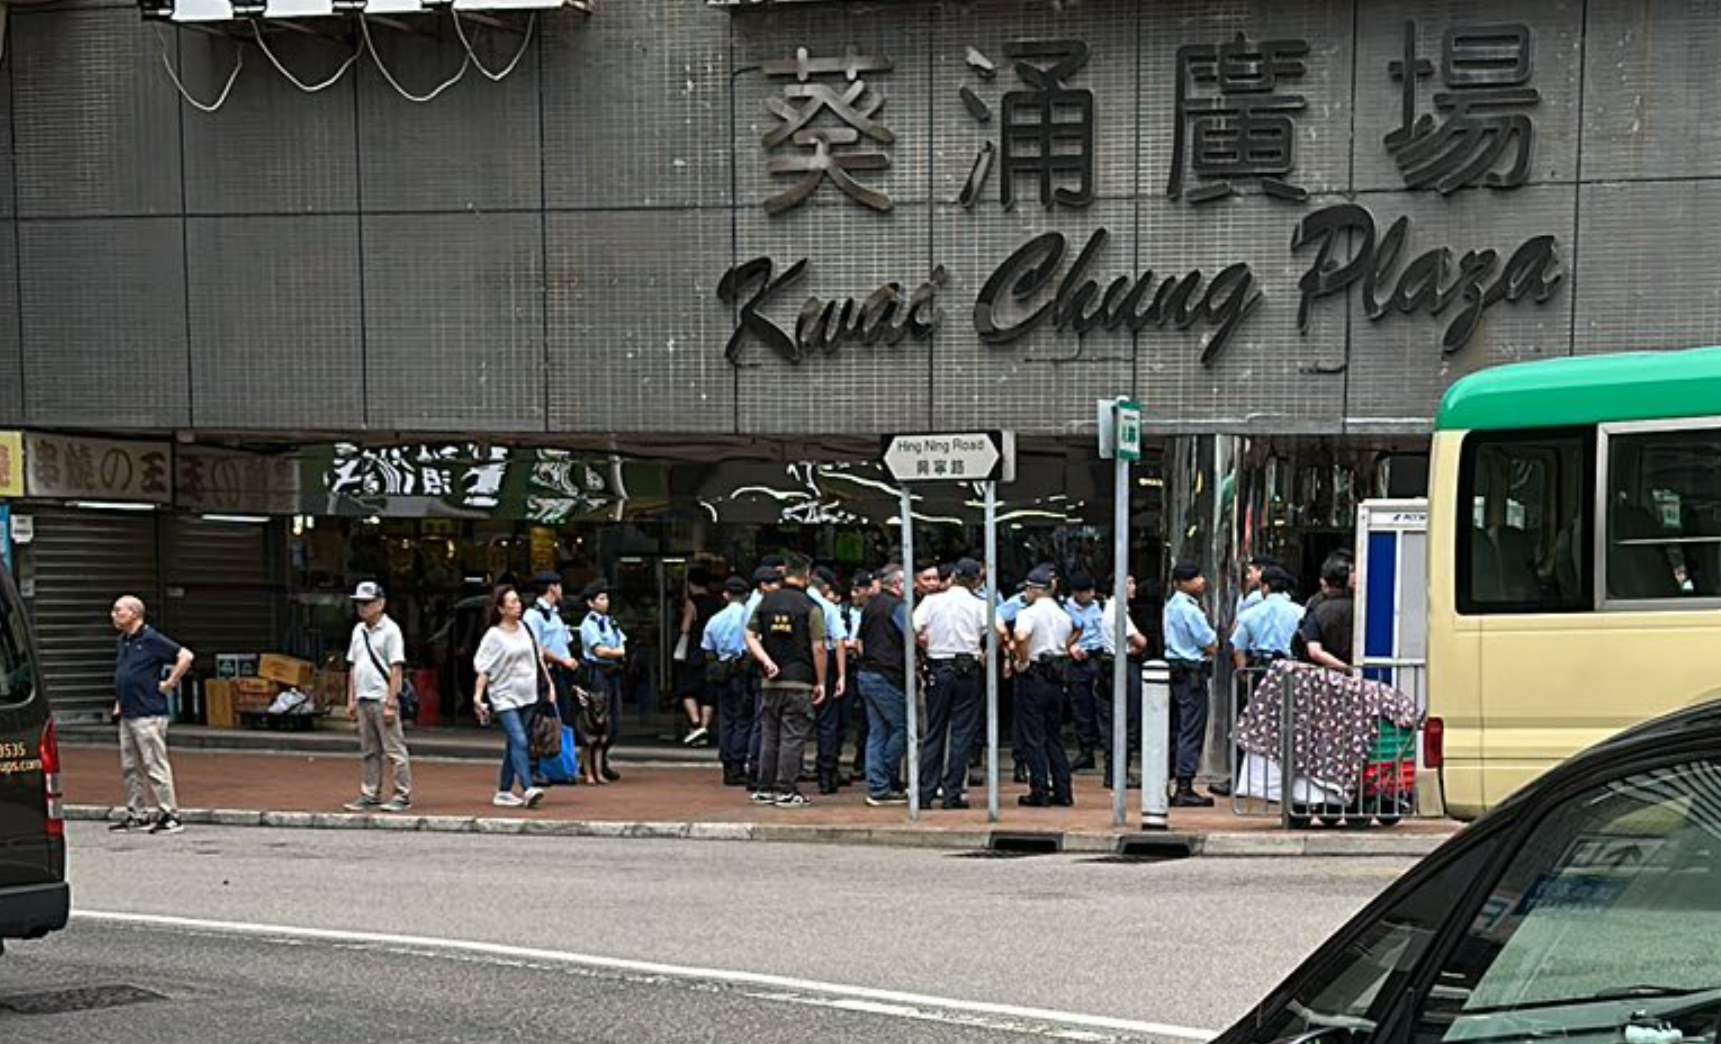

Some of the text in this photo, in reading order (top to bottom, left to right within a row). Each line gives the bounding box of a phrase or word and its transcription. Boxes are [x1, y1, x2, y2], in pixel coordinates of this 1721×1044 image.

[762, 20, 1541, 214] 葵涌廣場
[973, 227, 1263, 366] Chung
[1291, 203, 1562, 355] Plaza
[898, 438, 984, 454] Hing Ning Road
